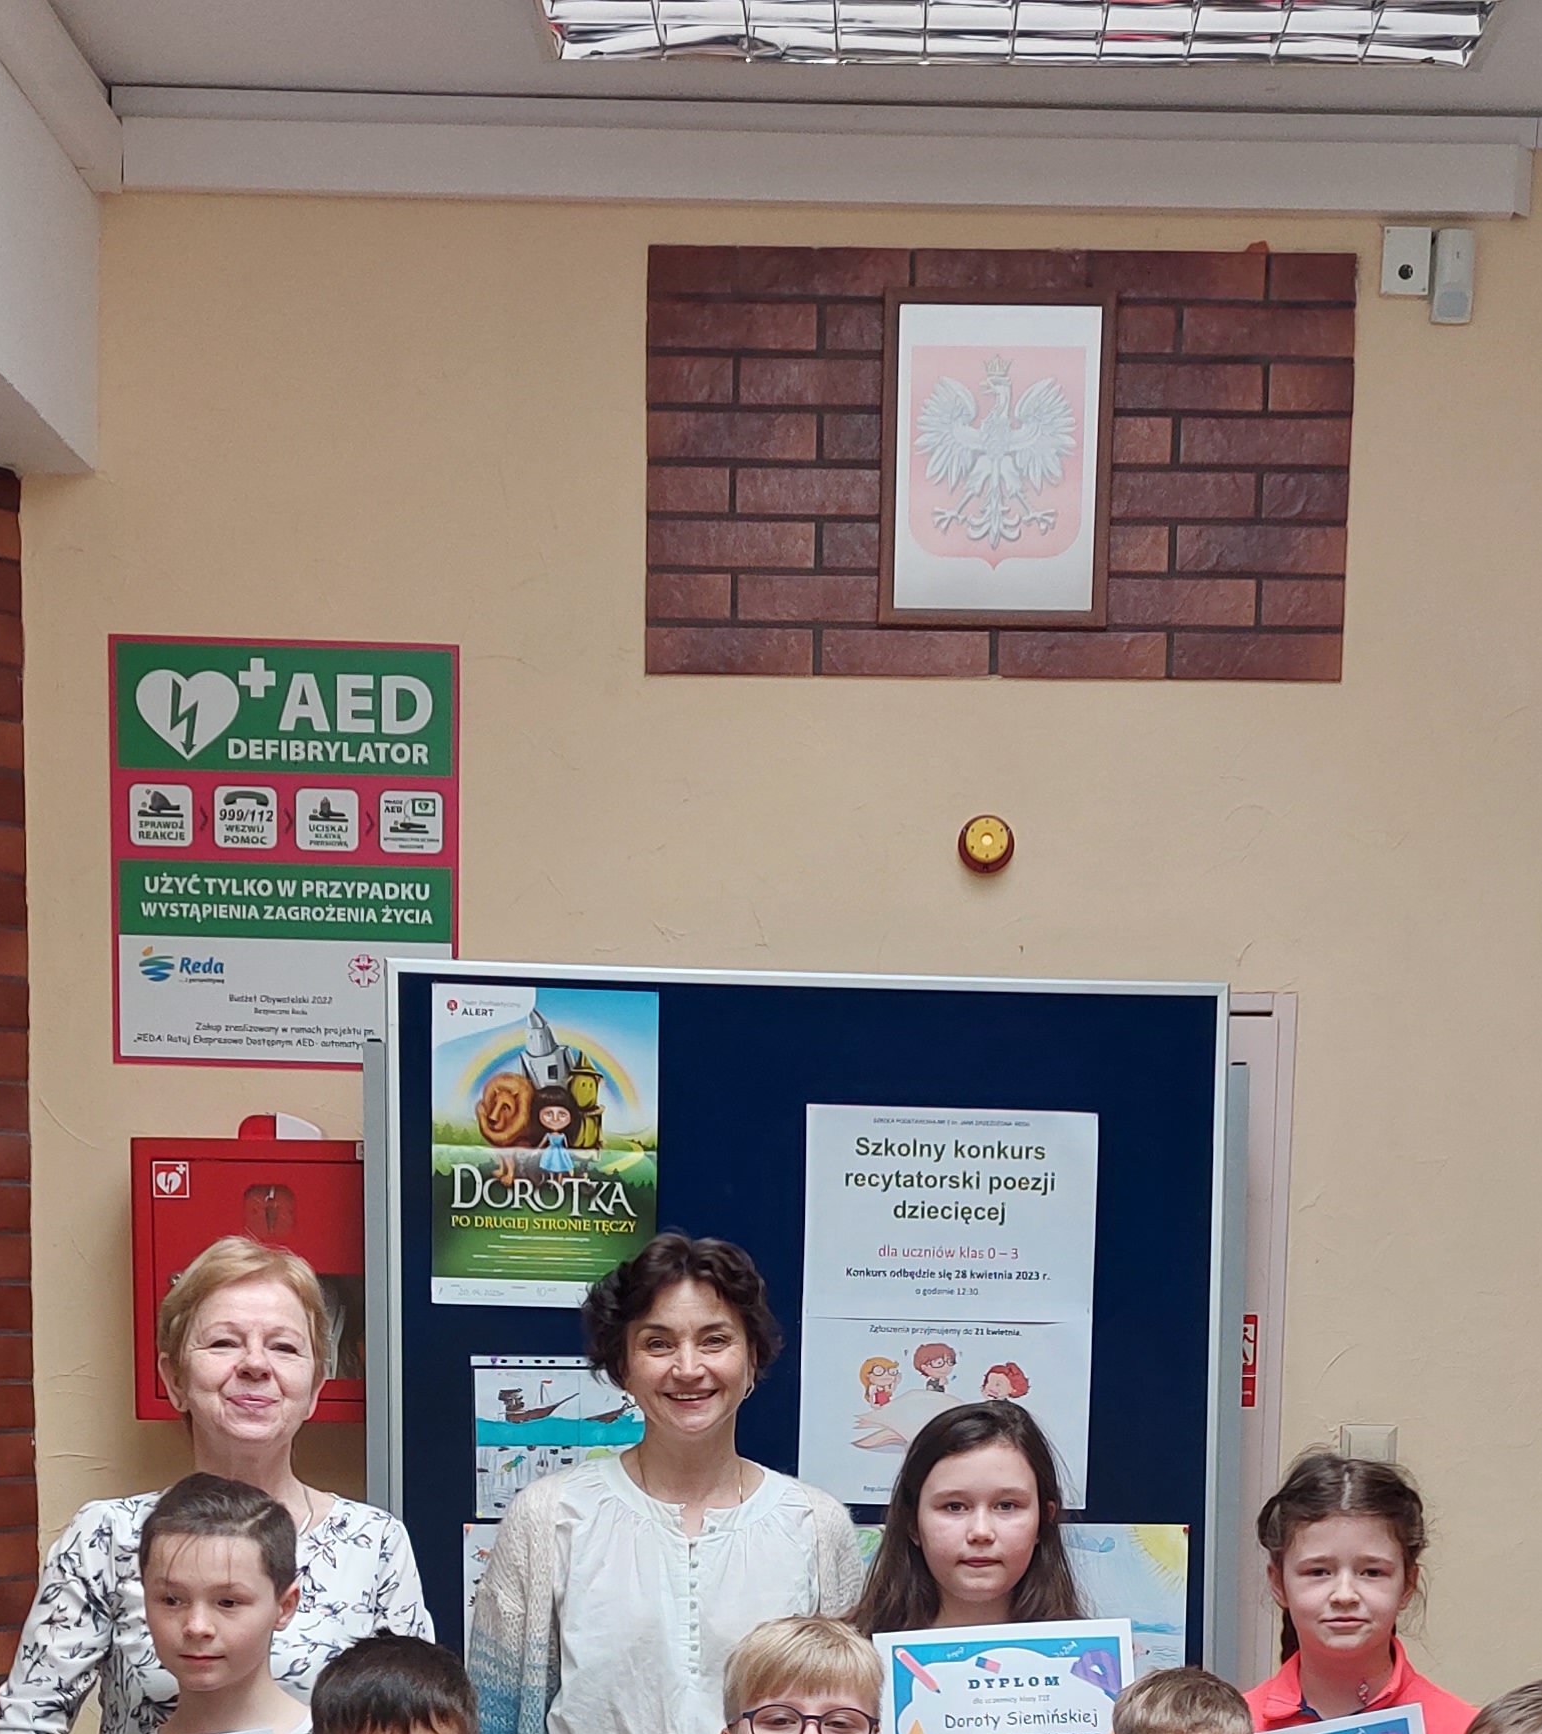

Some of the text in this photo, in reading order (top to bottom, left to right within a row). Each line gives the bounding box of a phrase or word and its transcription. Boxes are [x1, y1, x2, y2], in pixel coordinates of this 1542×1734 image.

[279, 673, 432, 734] AED
[228, 738, 429, 764] DEFIBRYLATOR
[219, 809, 273, 823] 999/112
[139, 820, 185, 830] SPRAWDŹ
[225, 824, 264, 834] WEZWIJ
[309, 825, 348, 834] UCISKAJ
[224, 835, 267, 845] POMOC
[144, 872, 430, 900] UŻYĆ TYLKO W PRZYPADKU
[141, 903, 433, 924] WYSTĄPIENIA ZAGROŻENIA ŻYCIA
[179, 957, 224, 975] Reda
[229, 994, 257, 1003] Budżet
[260, 995, 309, 1005] Obywatelski
[461, 1007, 495, 1017] ALERT
[290, 1026, 321, 1034] ramach
[324, 1026, 362, 1037] projektu
[855, 1136, 1046, 1162] Szkolny konkurs
[450, 1163, 637, 1217] DOROTKA
[845, 1170, 1055, 1195] recytatorski poezji
[893, 1200, 1006, 1225] dziecięcej
[451, 1215, 637, 1235] PO DRUGIEJ STRONIE TĘCZY
[878, 1245, 1018, 1260] dla uczniów klas 0 3
[846, 1268, 886, 1277] Konkurs
[890, 1268, 935, 1279] odbędzie
[938, 1269, 952, 1280] się
[955, 1270, 967, 1279] 28
[970, 1270, 1012, 1280] kwietnia
[1015, 1272, 1039, 1280] 2023
[869, 1325, 909, 1334] Zgłoszenia
[912, 1326, 960, 1337] przyjmujemy
[968, 1676, 1060, 1689] DYPLOM
[945, 1708, 1098, 1730] Doroty Siemińskiej
